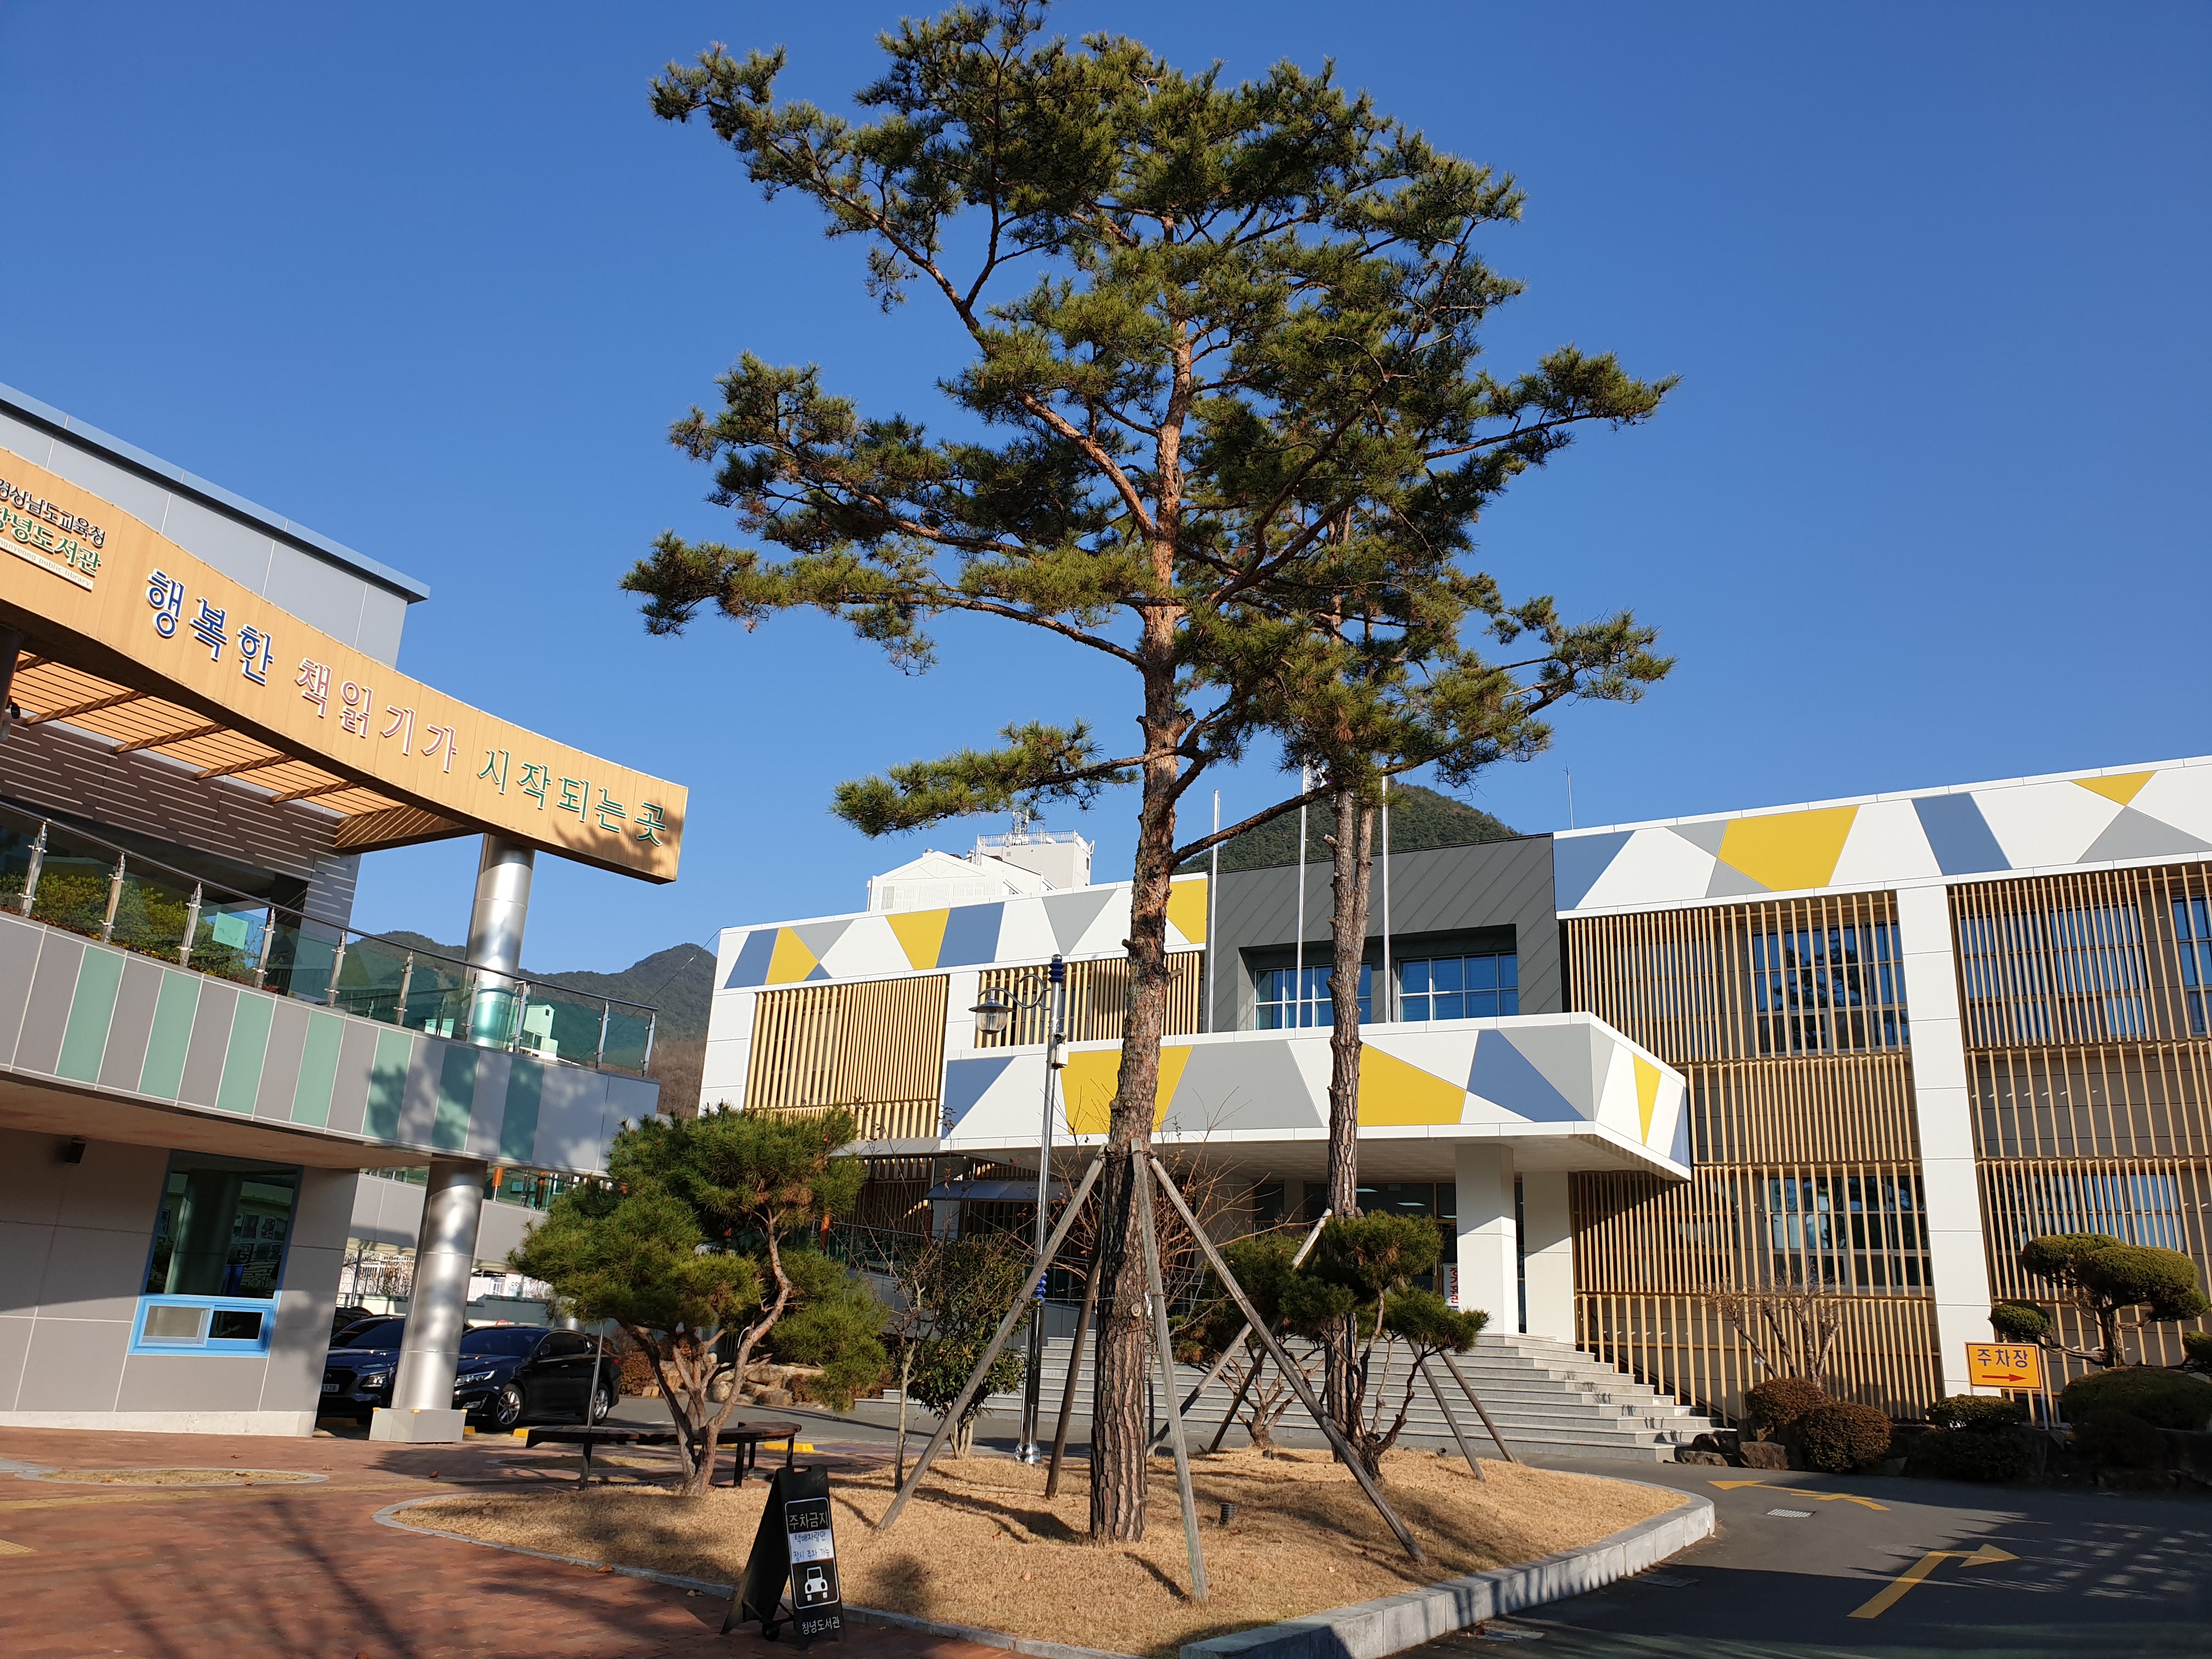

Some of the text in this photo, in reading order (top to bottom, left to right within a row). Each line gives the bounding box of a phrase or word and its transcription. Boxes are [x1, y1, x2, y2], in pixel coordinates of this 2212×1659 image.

[38, 558, 63, 573] public
[65, 569, 91, 586] library
[146, 568, 667, 847] 행복한 책읽기가 시작되는 곳
[1977, 1348, 2028, 1368] 주차장
[789, 1510, 828, 1530] 주차금지
[819, 1547, 830, 1558] 가능
[802, 1616, 840, 1635] 창녕도서관
